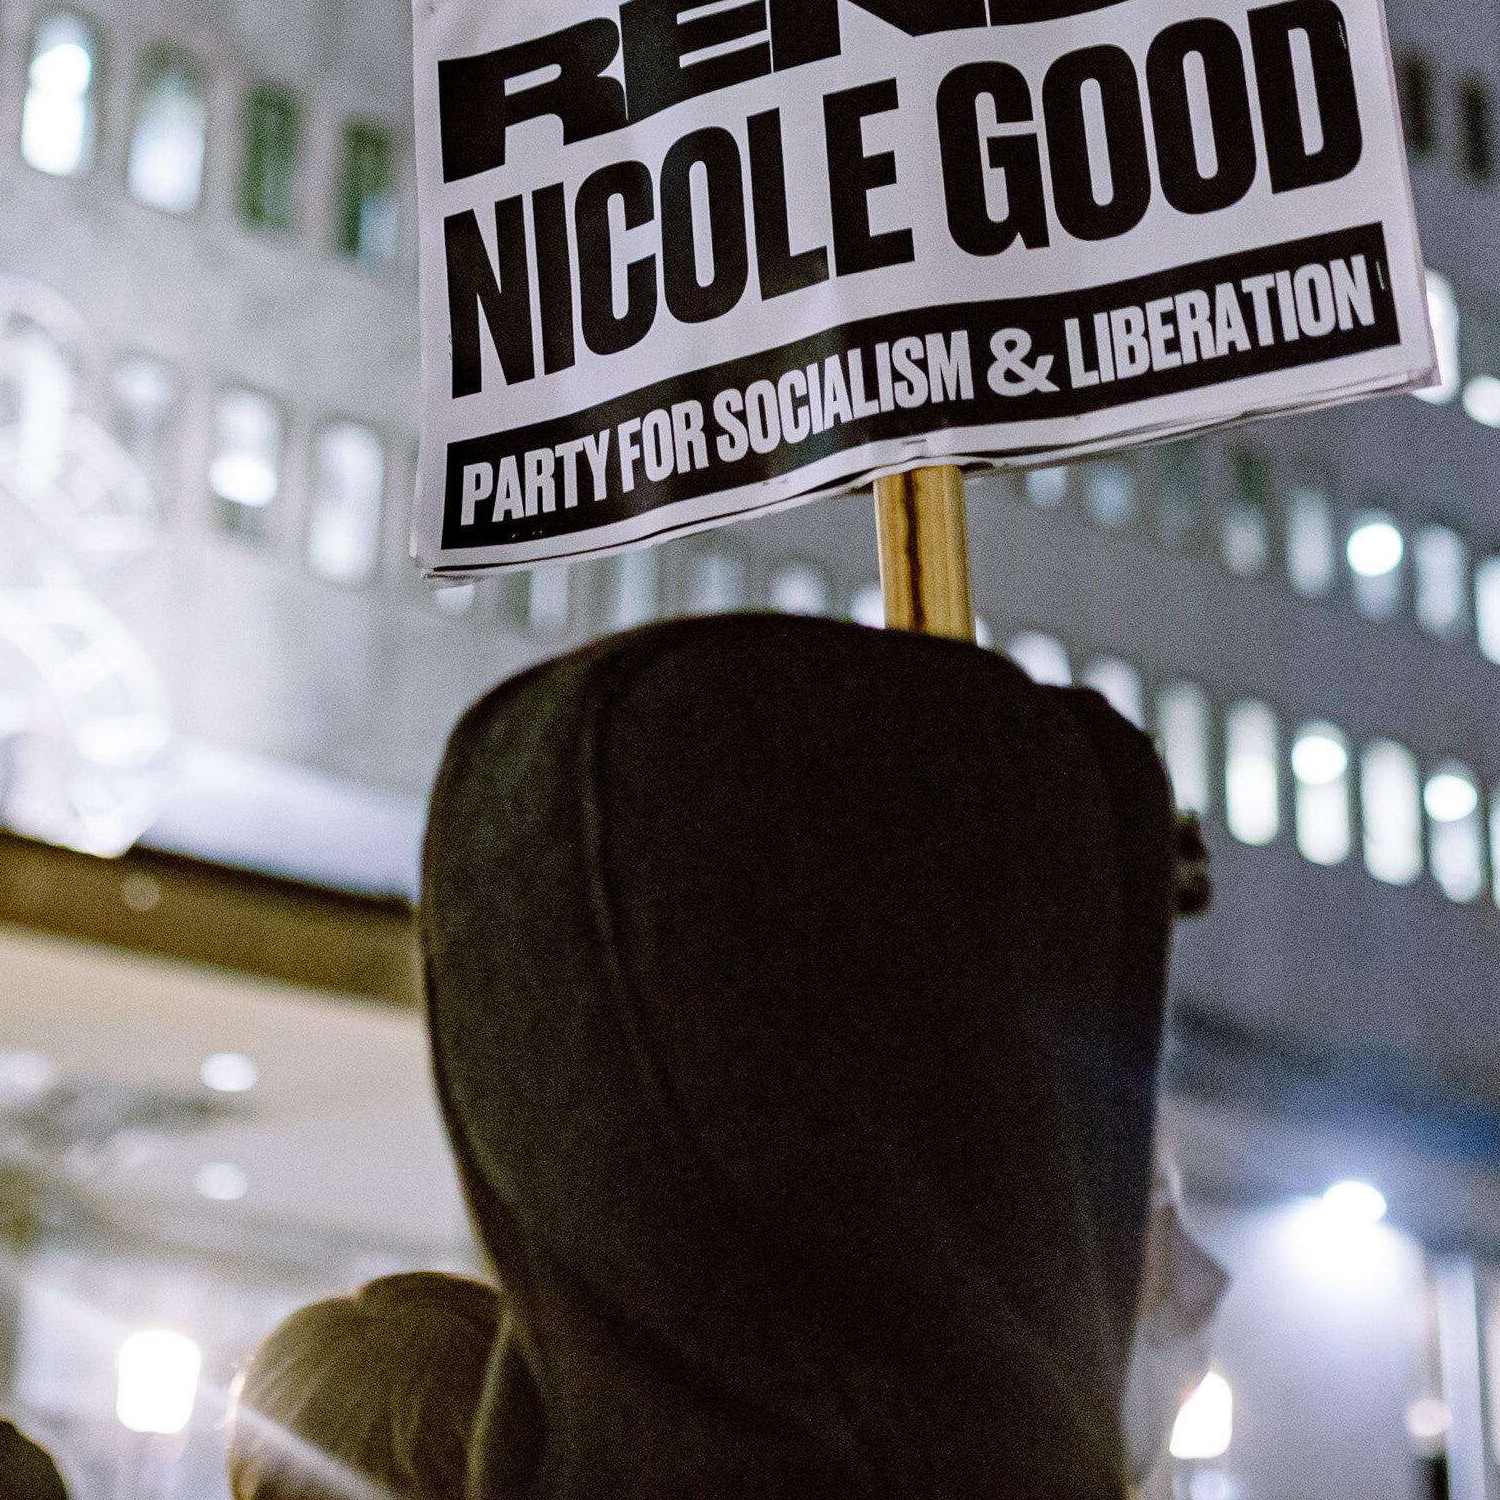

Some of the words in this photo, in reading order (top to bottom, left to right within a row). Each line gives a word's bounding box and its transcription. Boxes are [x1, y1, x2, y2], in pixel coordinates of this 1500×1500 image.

[443, 76, 916, 400] NICOLE
[460, 428, 611, 526] PARTY
[617, 400, 710, 494] FOR
[712, 329, 975, 463] SOCIALISM
[986, 328, 1061, 398] &
[1063, 253, 1376, 391] LIBERATION
